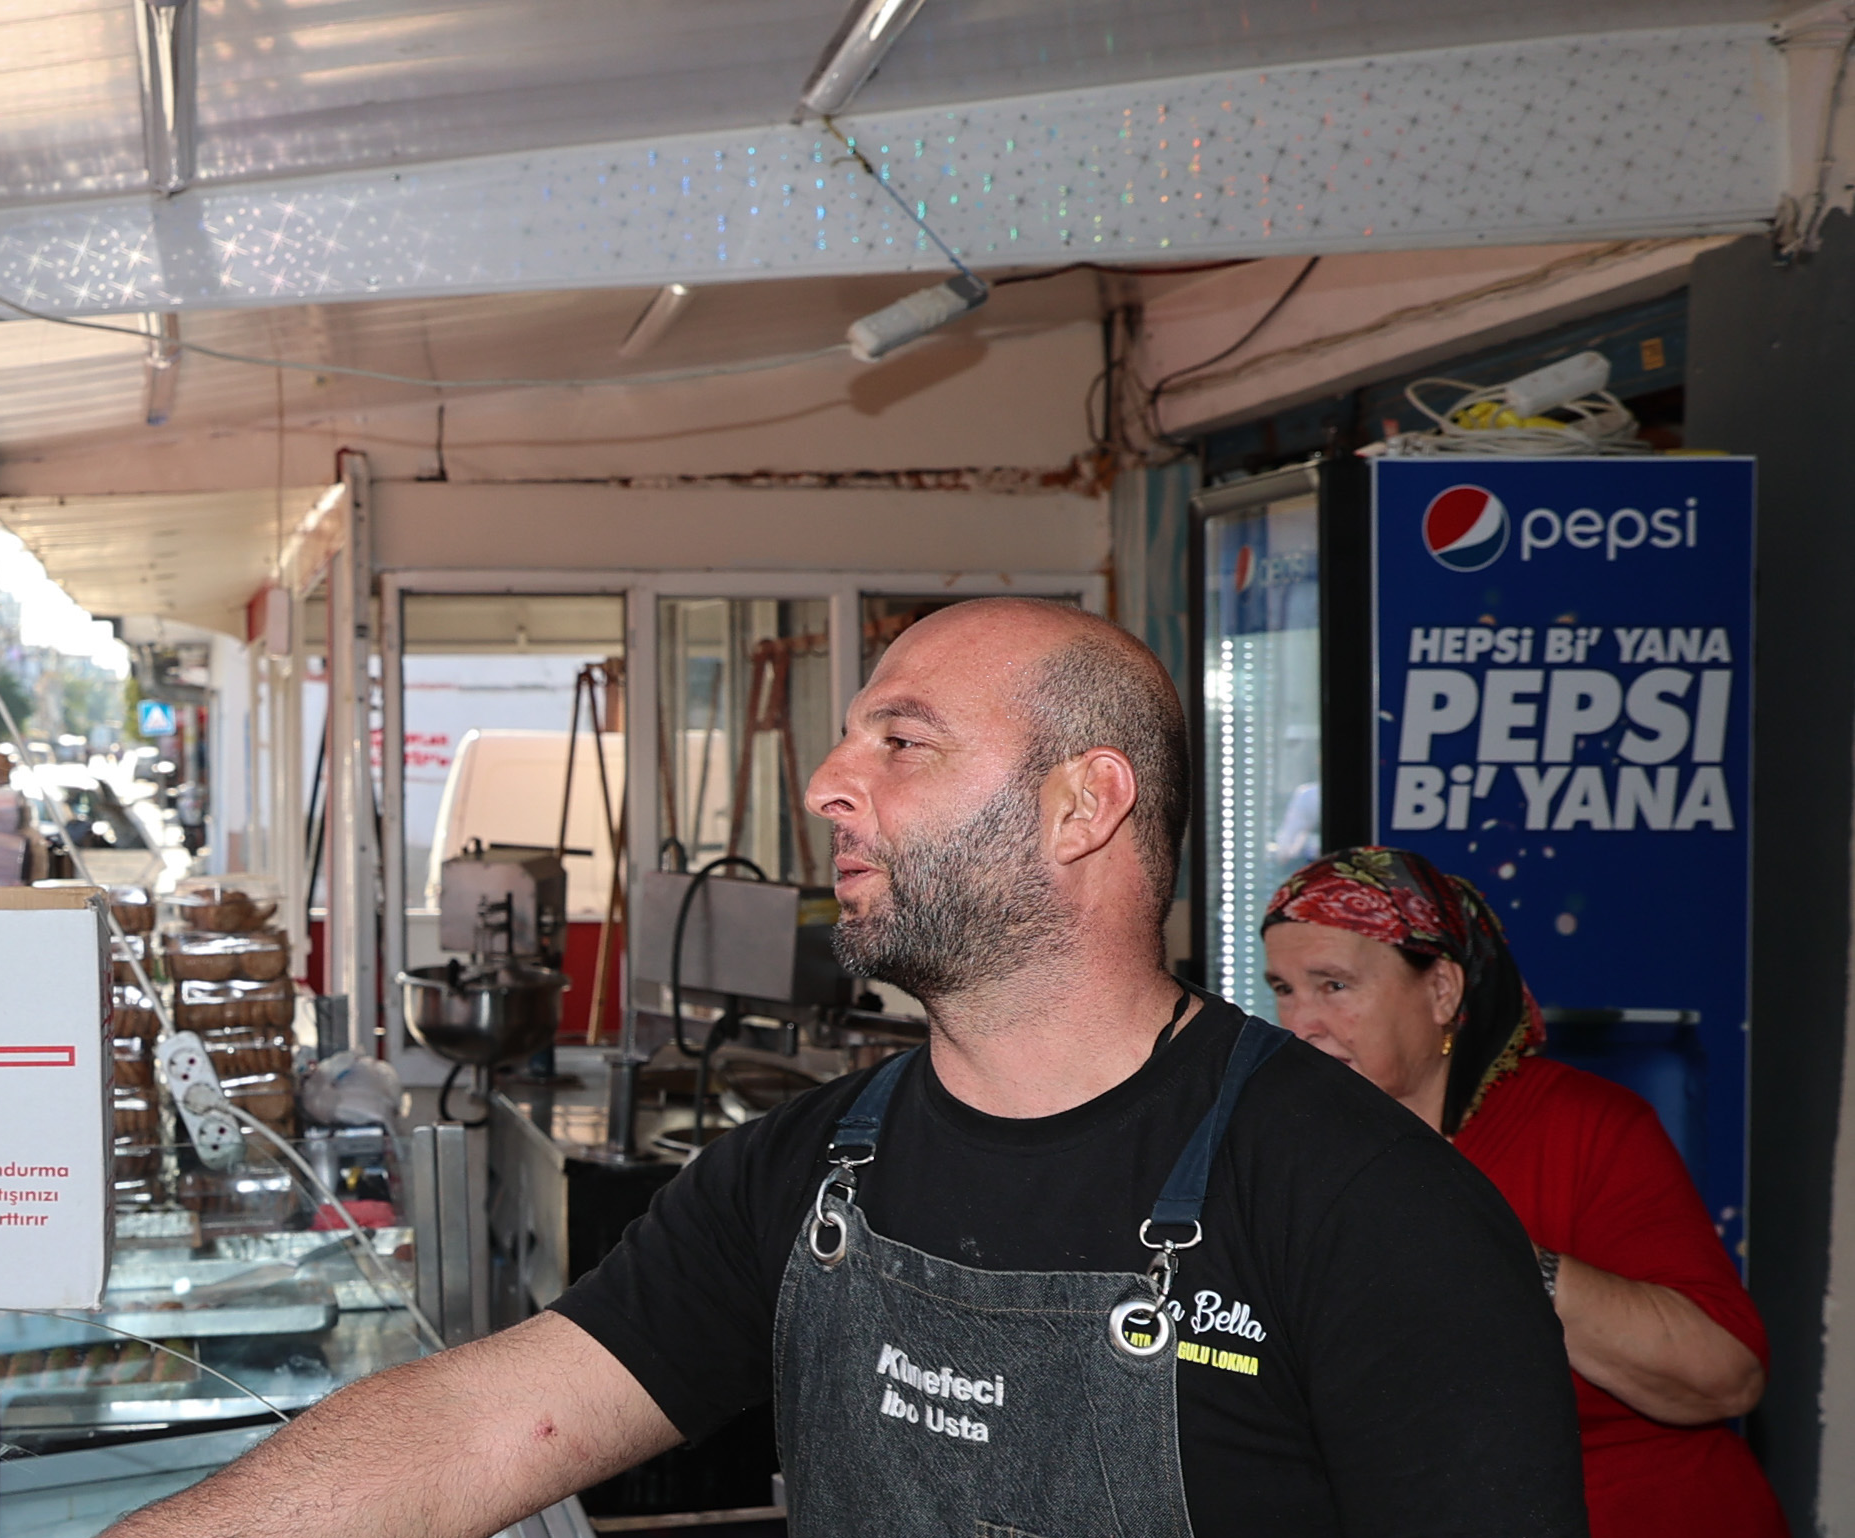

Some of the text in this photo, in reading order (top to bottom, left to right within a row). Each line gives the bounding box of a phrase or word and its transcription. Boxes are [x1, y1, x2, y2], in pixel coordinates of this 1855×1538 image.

[1521, 497, 1697, 561] pepsi
[1613, 628, 1732, 664] YANA
[1398, 668, 1733, 765] PEPSI
[1514, 765, 1734, 831] YANA
[1190, 1289, 1267, 1343] Bella
[1211, 1348, 1260, 1376] LOKMA
[925, 1404, 989, 1442] Usta
